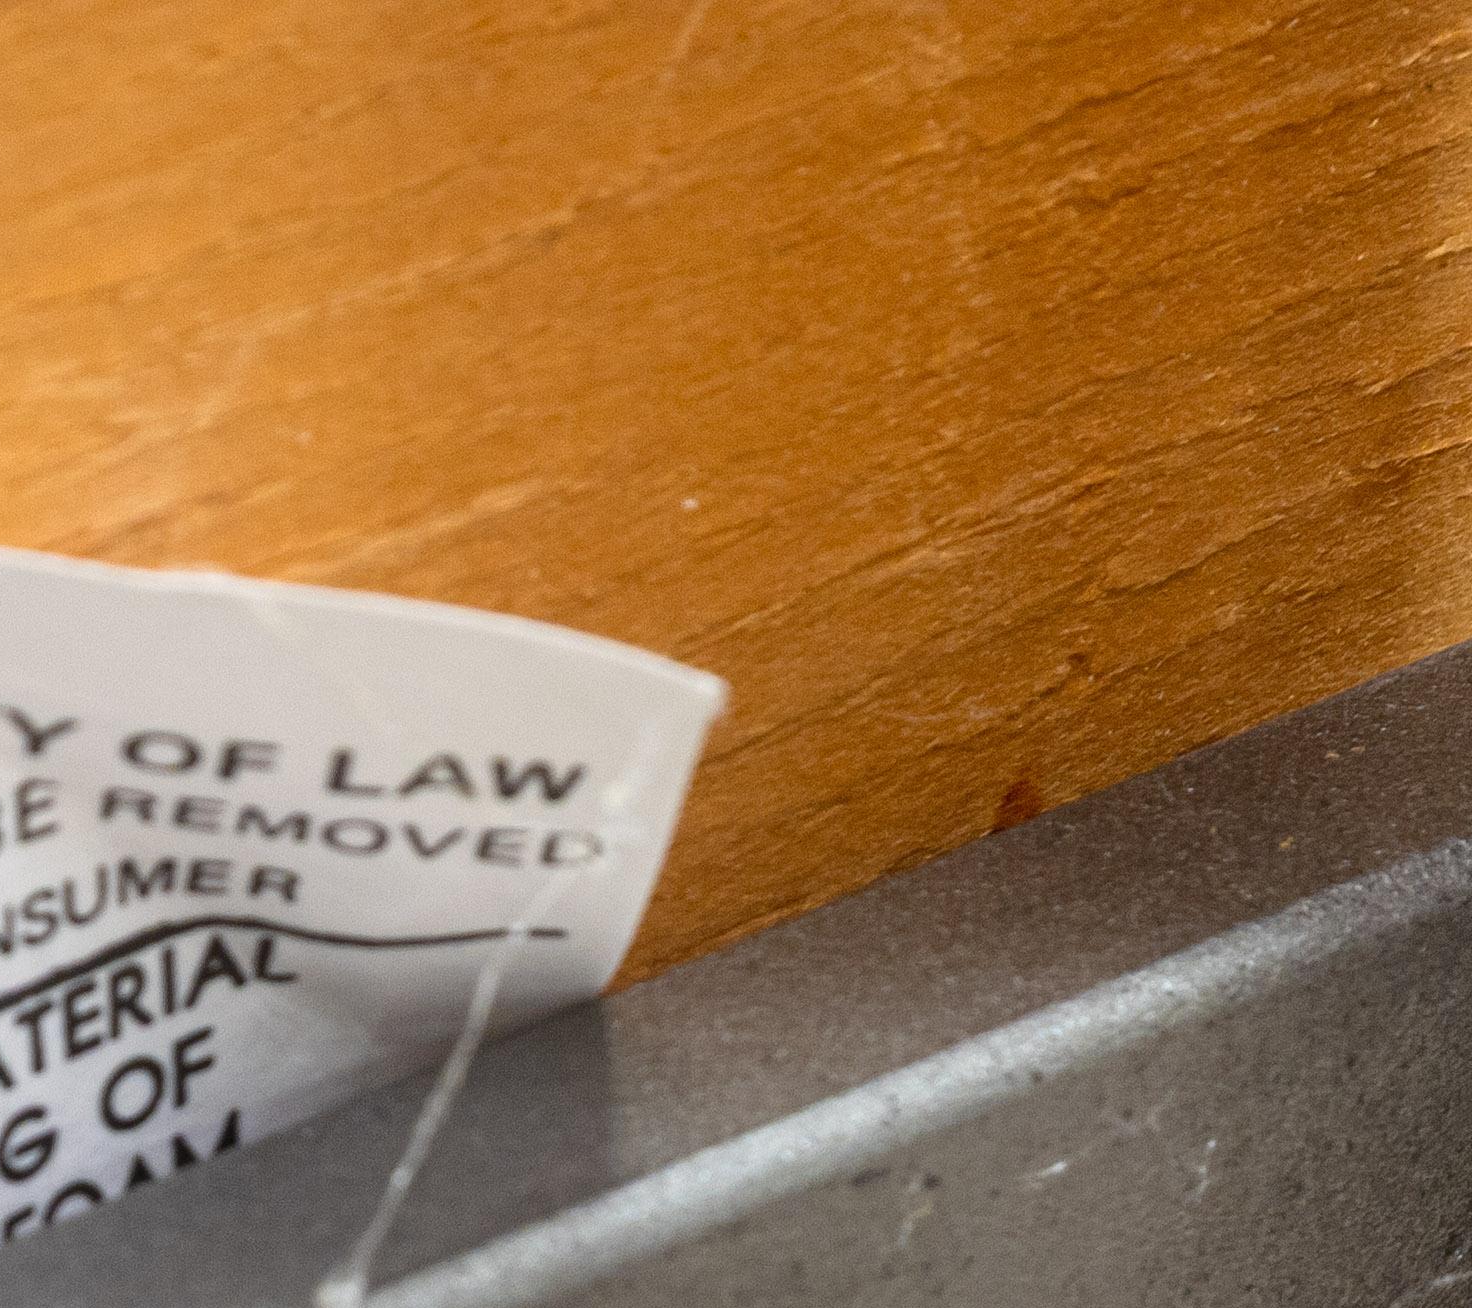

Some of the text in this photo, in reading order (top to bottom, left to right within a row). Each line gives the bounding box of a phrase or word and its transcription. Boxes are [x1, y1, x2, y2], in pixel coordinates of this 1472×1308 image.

[121, 729, 279, 782] OF
[326, 747, 588, 803] LAW
[99, 786, 604, 867] REMOVED
[100, 1026, 216, 1133] OF
